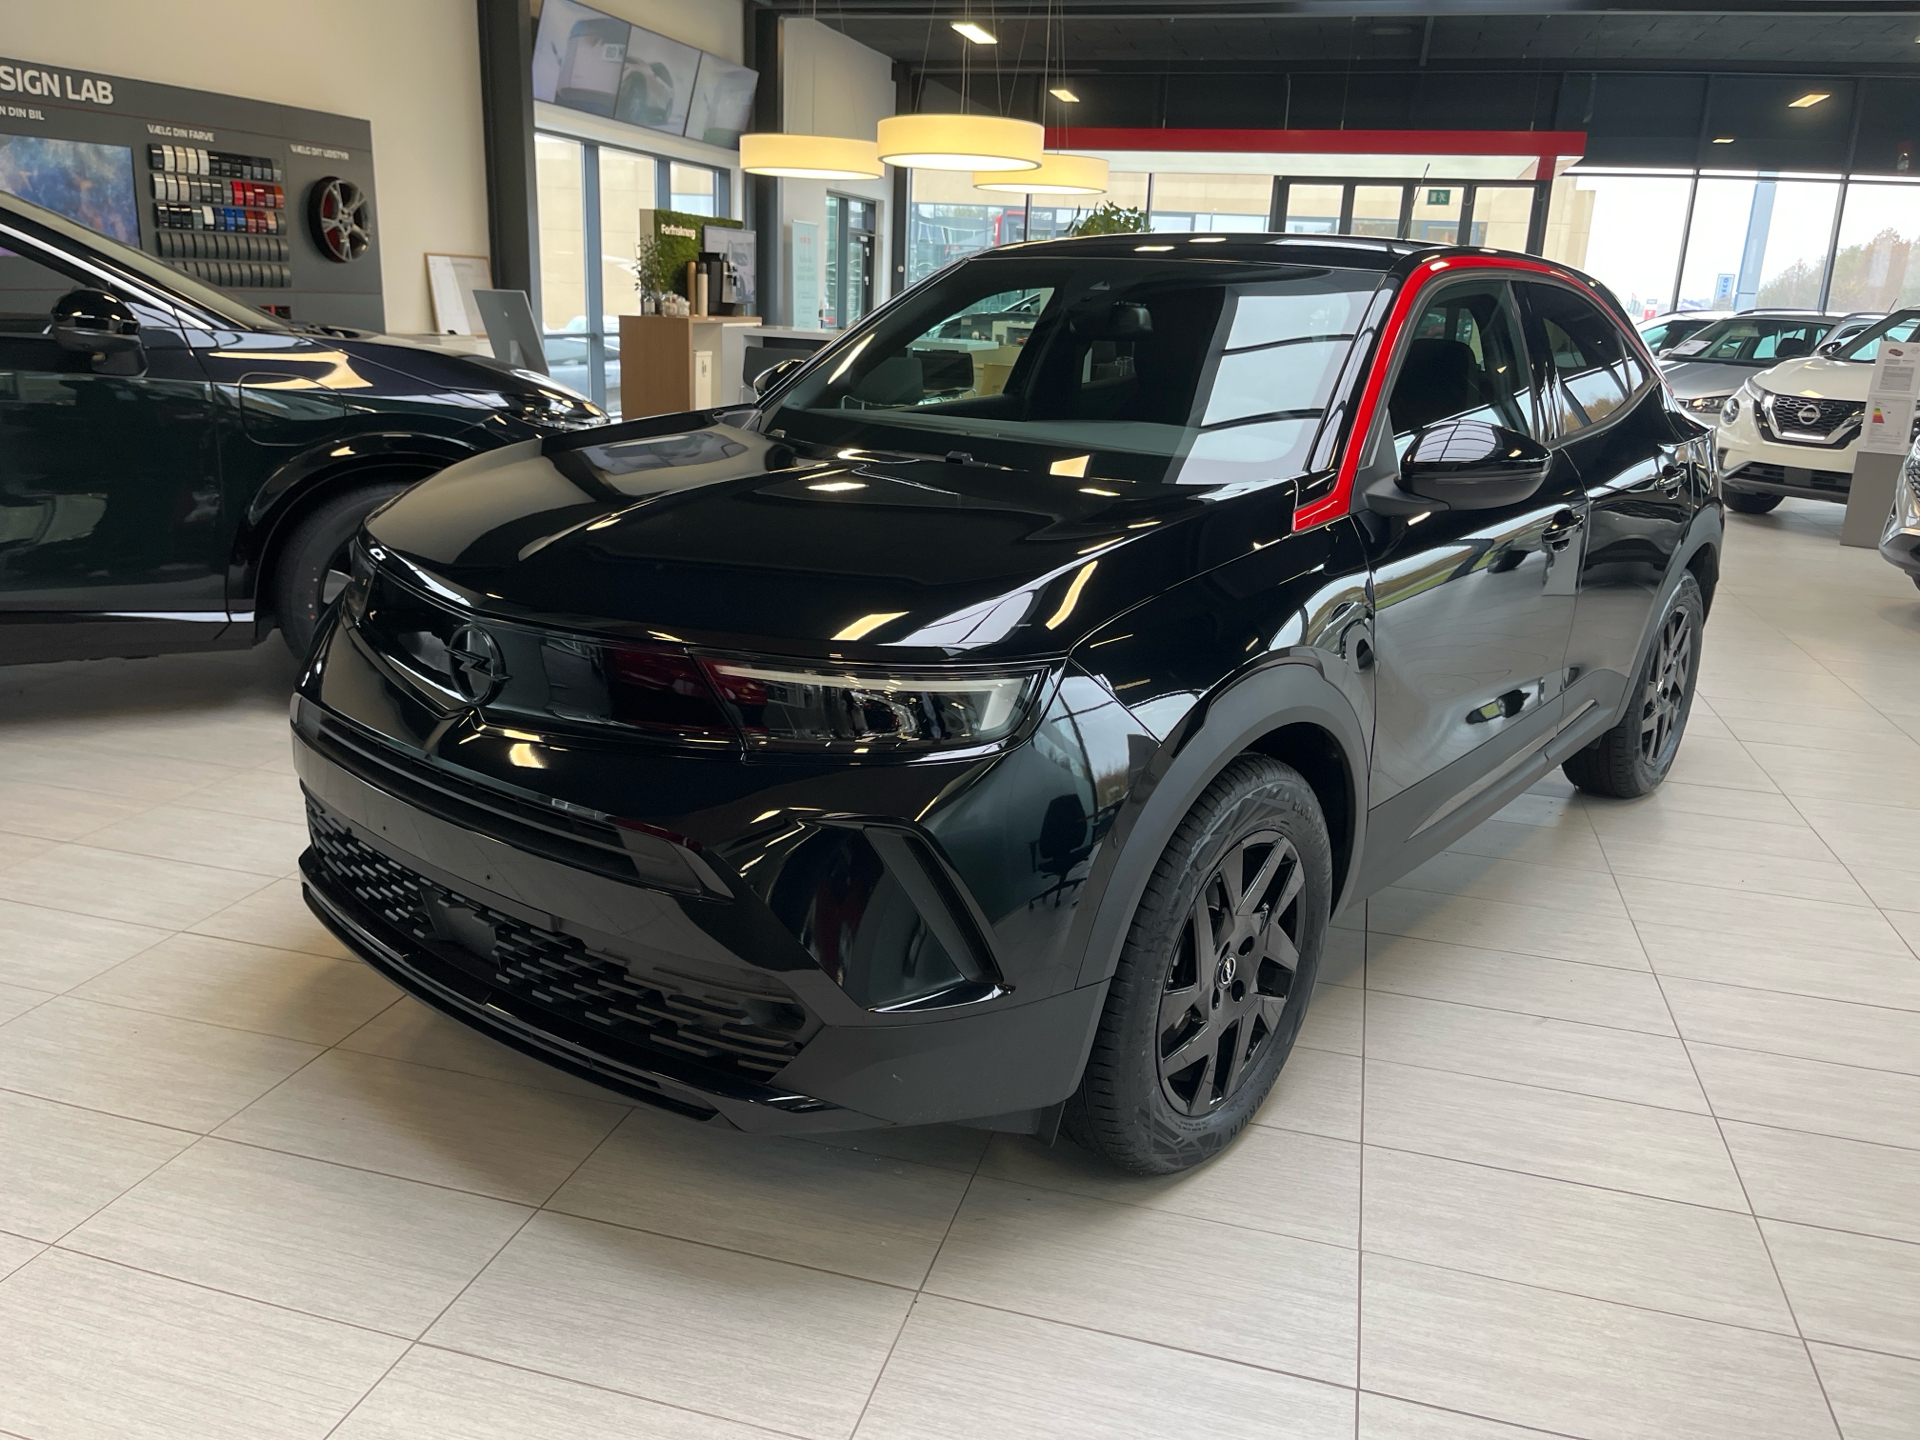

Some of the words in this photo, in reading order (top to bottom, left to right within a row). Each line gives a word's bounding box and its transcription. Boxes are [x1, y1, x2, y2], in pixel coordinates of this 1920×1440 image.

[0, 65, 61, 98] SIGN
[65, 75, 114, 105] LAB
[8, 106, 27, 118] DIN
[28, 109, 45, 120] BIL
[172, 127, 188, 138] DIN
